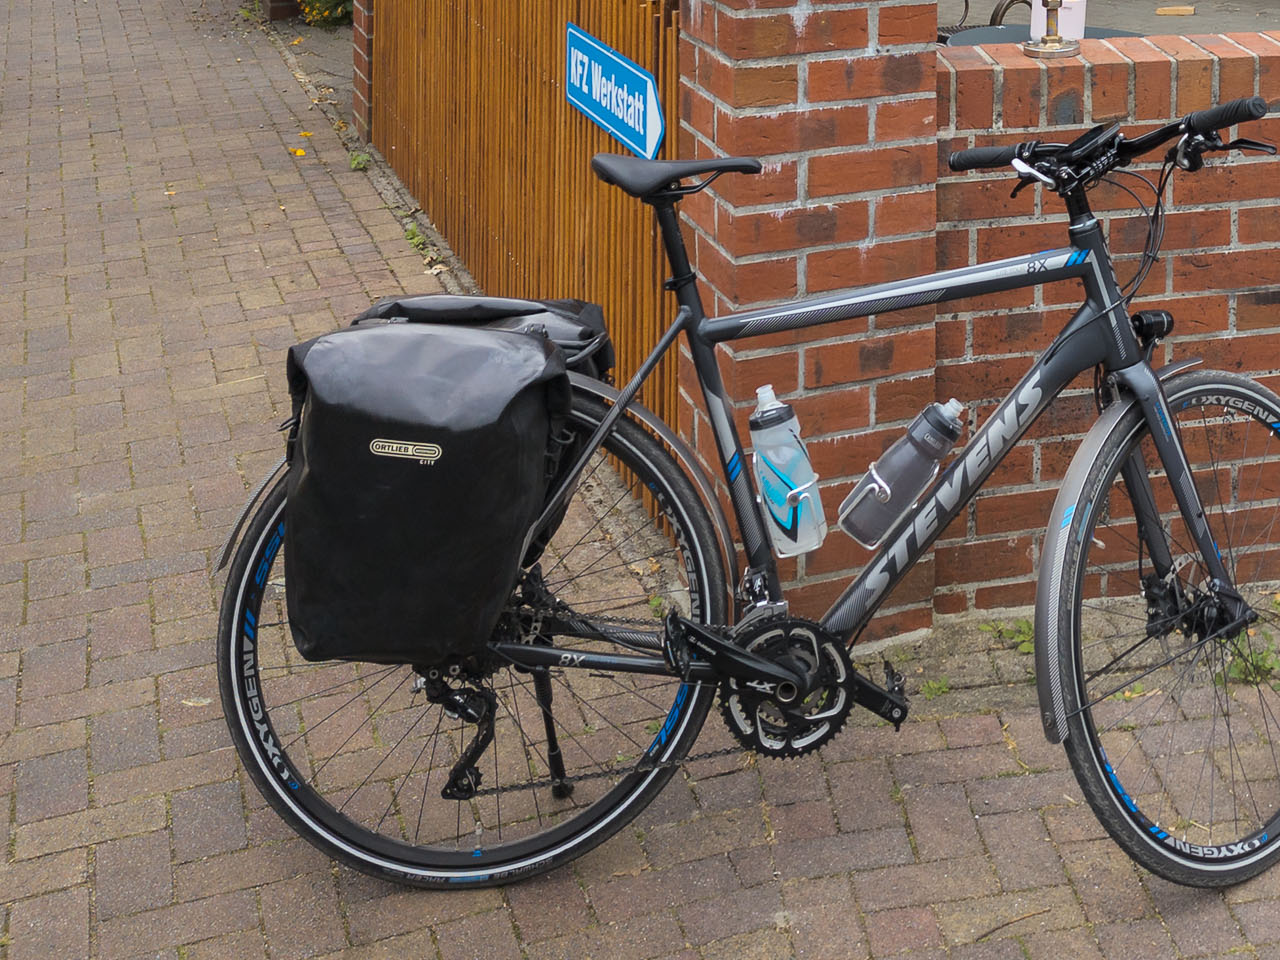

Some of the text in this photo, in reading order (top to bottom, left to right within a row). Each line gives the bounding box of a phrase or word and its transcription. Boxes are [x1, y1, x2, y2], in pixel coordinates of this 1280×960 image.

[570, 46, 645, 135] KFZ Werkstatt
[1027, 259, 1048, 274] 8X
[374, 443, 410, 453] ORTLIEB
[865, 369, 1042, 610] STEVENS
[558, 653, 585, 667] 8X
